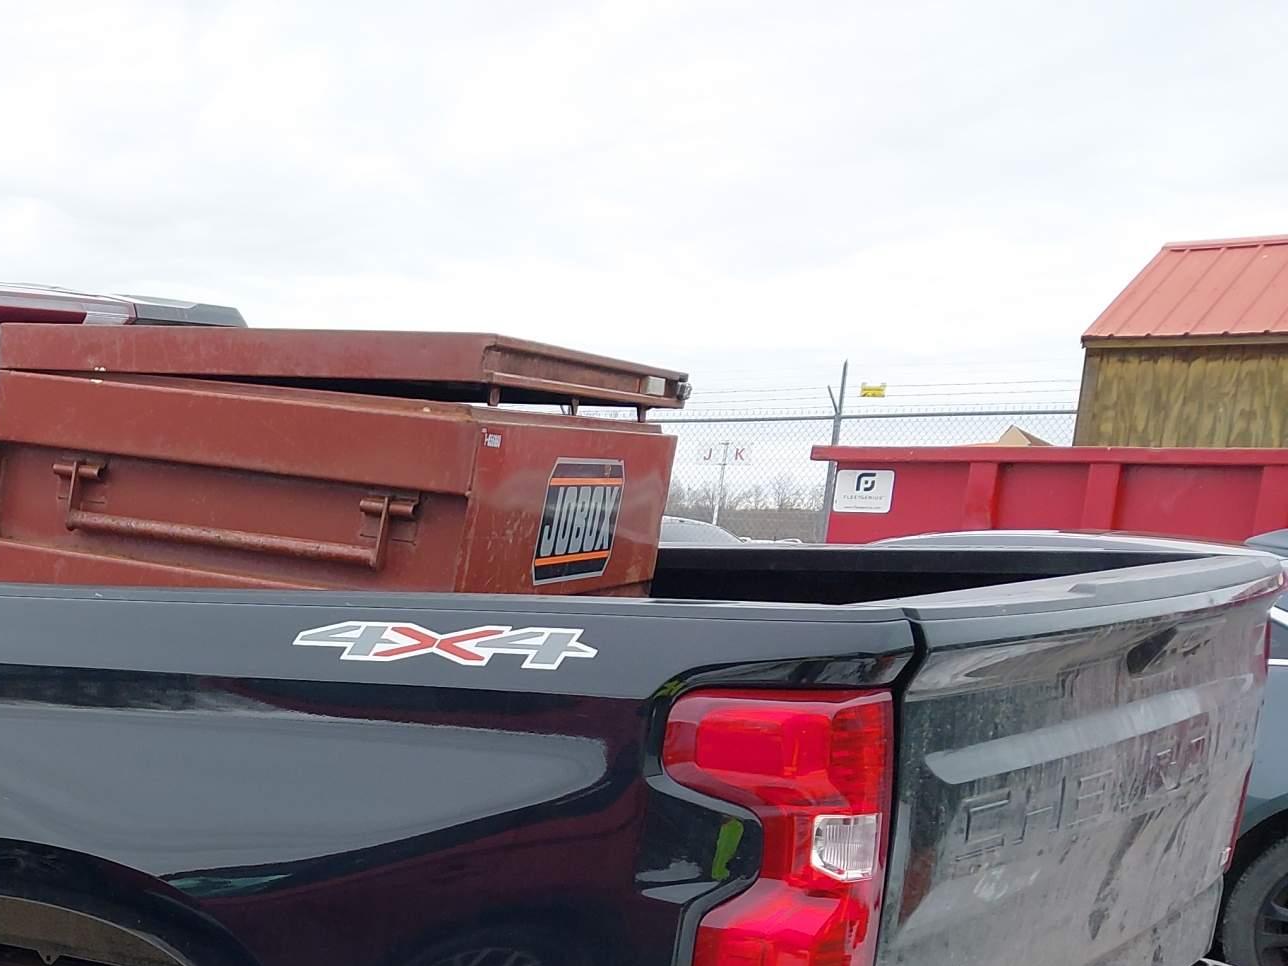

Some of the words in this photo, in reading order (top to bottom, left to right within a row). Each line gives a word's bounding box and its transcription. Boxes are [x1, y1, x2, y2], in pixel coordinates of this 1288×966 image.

[703, 447, 713, 461] J
[734, 447, 746, 461] K
[539, 486, 620, 557] JOBOX
